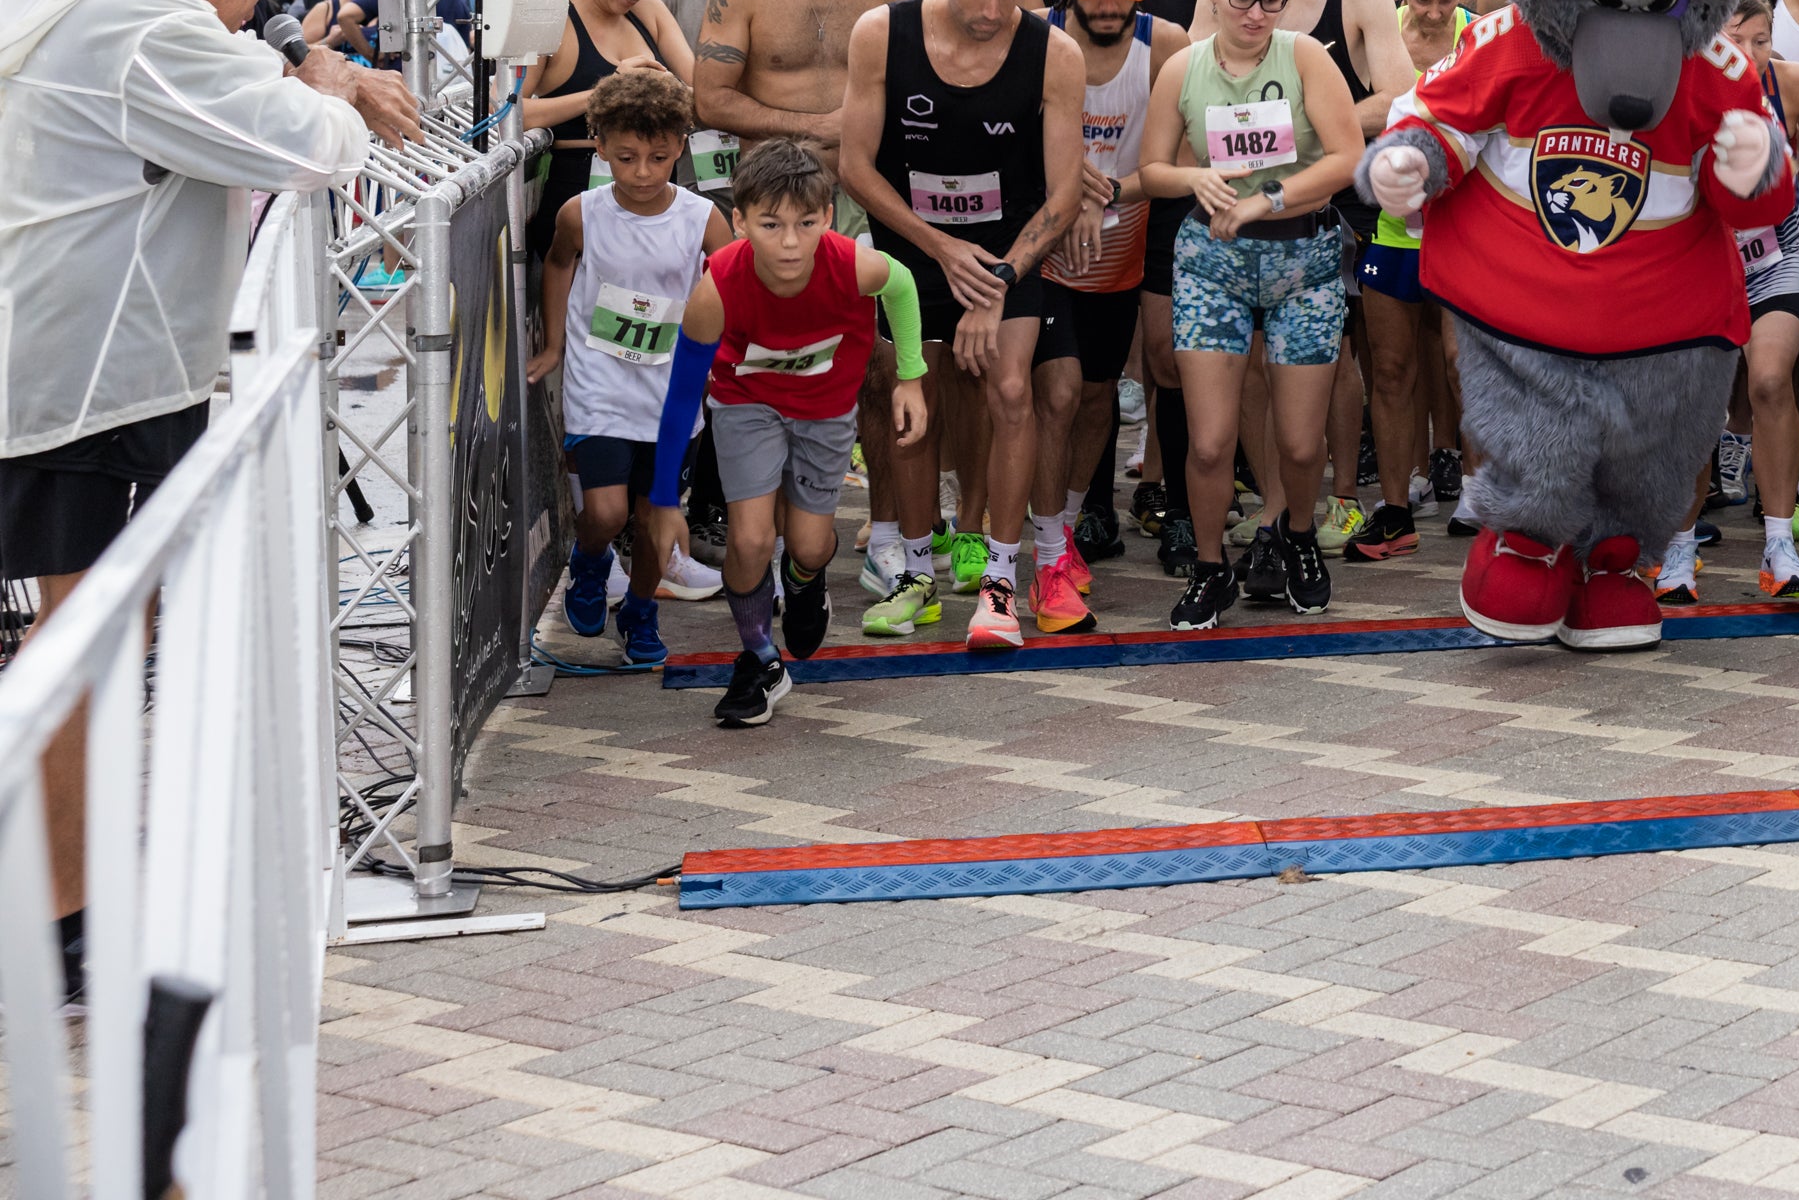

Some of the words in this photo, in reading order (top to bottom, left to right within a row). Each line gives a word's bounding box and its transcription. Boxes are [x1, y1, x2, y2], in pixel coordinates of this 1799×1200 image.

[1082, 125, 1125, 140] EPOT
[1222, 130, 1278, 156] 1482
[1545, 136, 1641, 168] PANTHERS
[1248, 160, 1264, 169] BEER
[928, 195, 984, 212] 1403
[613, 316, 662, 350] 711
[625, 350, 641, 362] BEER
[766, 354, 815, 370] 713
